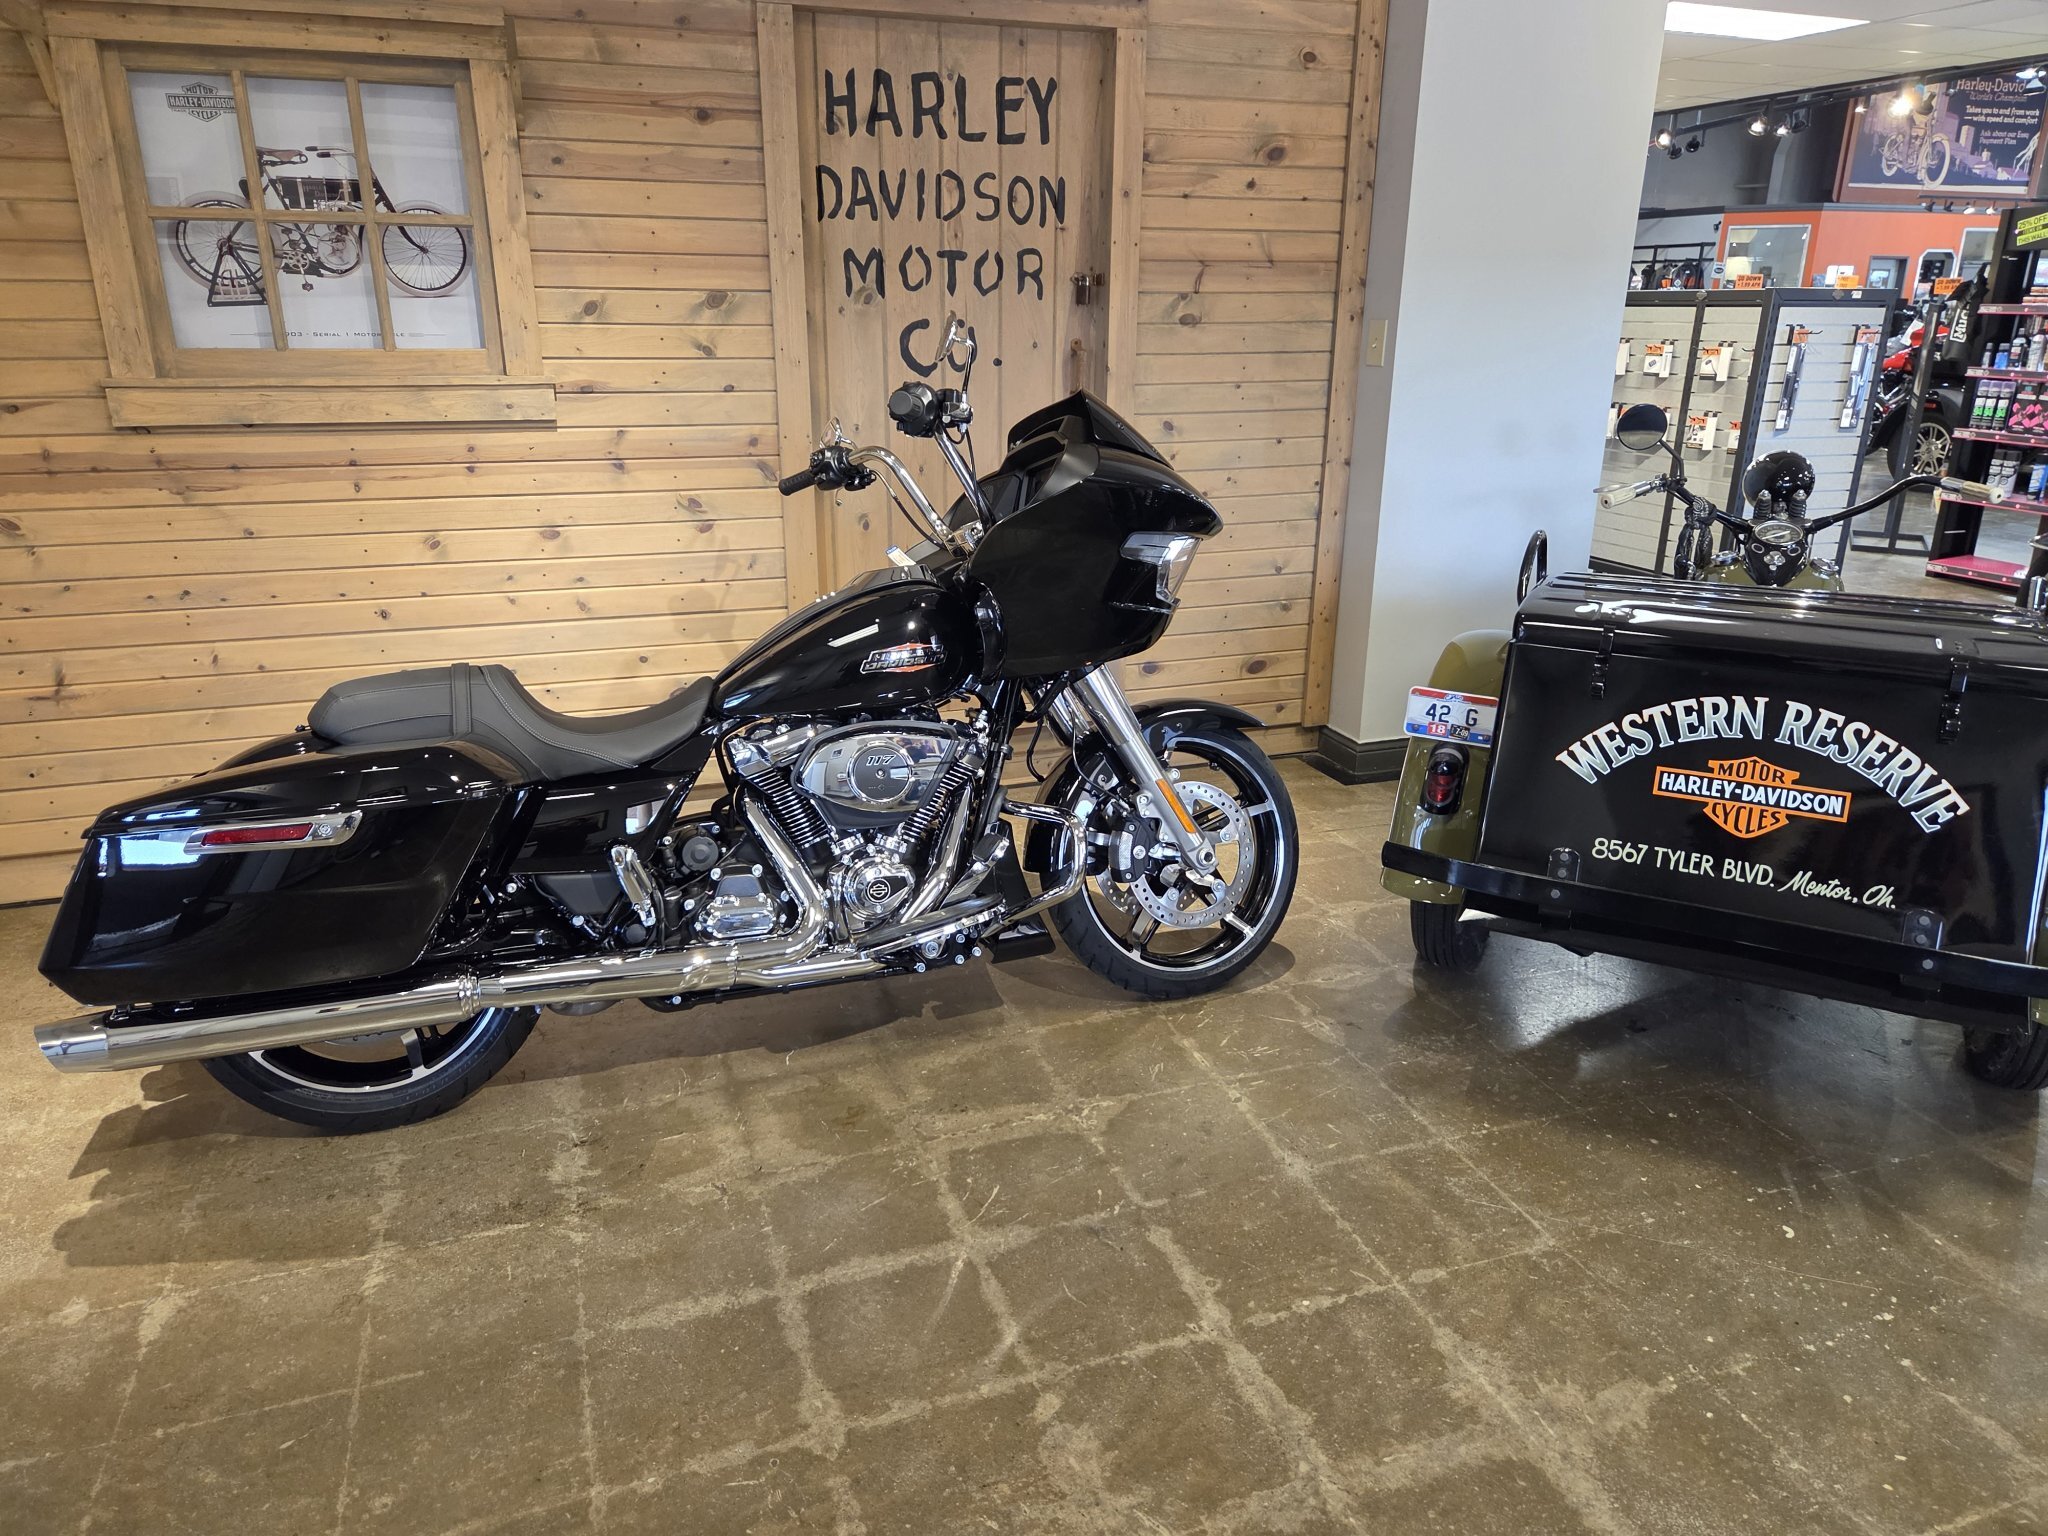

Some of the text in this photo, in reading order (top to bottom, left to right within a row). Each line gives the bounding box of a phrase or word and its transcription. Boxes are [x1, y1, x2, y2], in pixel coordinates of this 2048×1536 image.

[185, 84, 215, 95] MOTOR
[1956, 78, 2027, 93] Harley-David
[191, 110, 219, 120] CYCLES
[825, 67, 1058, 145] HARLEY
[1966, 105, 2040, 117] Takes you to and from work
[1986, 116, 2002, 124] speed
[2015, 117, 2038, 126] comfort
[815, 164, 1066, 229] DAVIDSON
[2033, 214, 2048, 225] OFF
[842, 244, 1044, 301] MOTOR
[1425, 703, 1479, 727] 42 G
[1429, 724, 1446, 734] 18
[865, 755, 897, 766] 117
[1559, 695, 1971, 834] WESTERN RESERVE
[1717, 756, 1786, 785] MOTOR
[1660, 772, 1843, 816] HARLEY-DAVIDSON
[1711, 801, 1782, 835] CYCLES
[1591, 837, 1897, 910] 8567 TYLER BLVD. Mentor, Oh.
